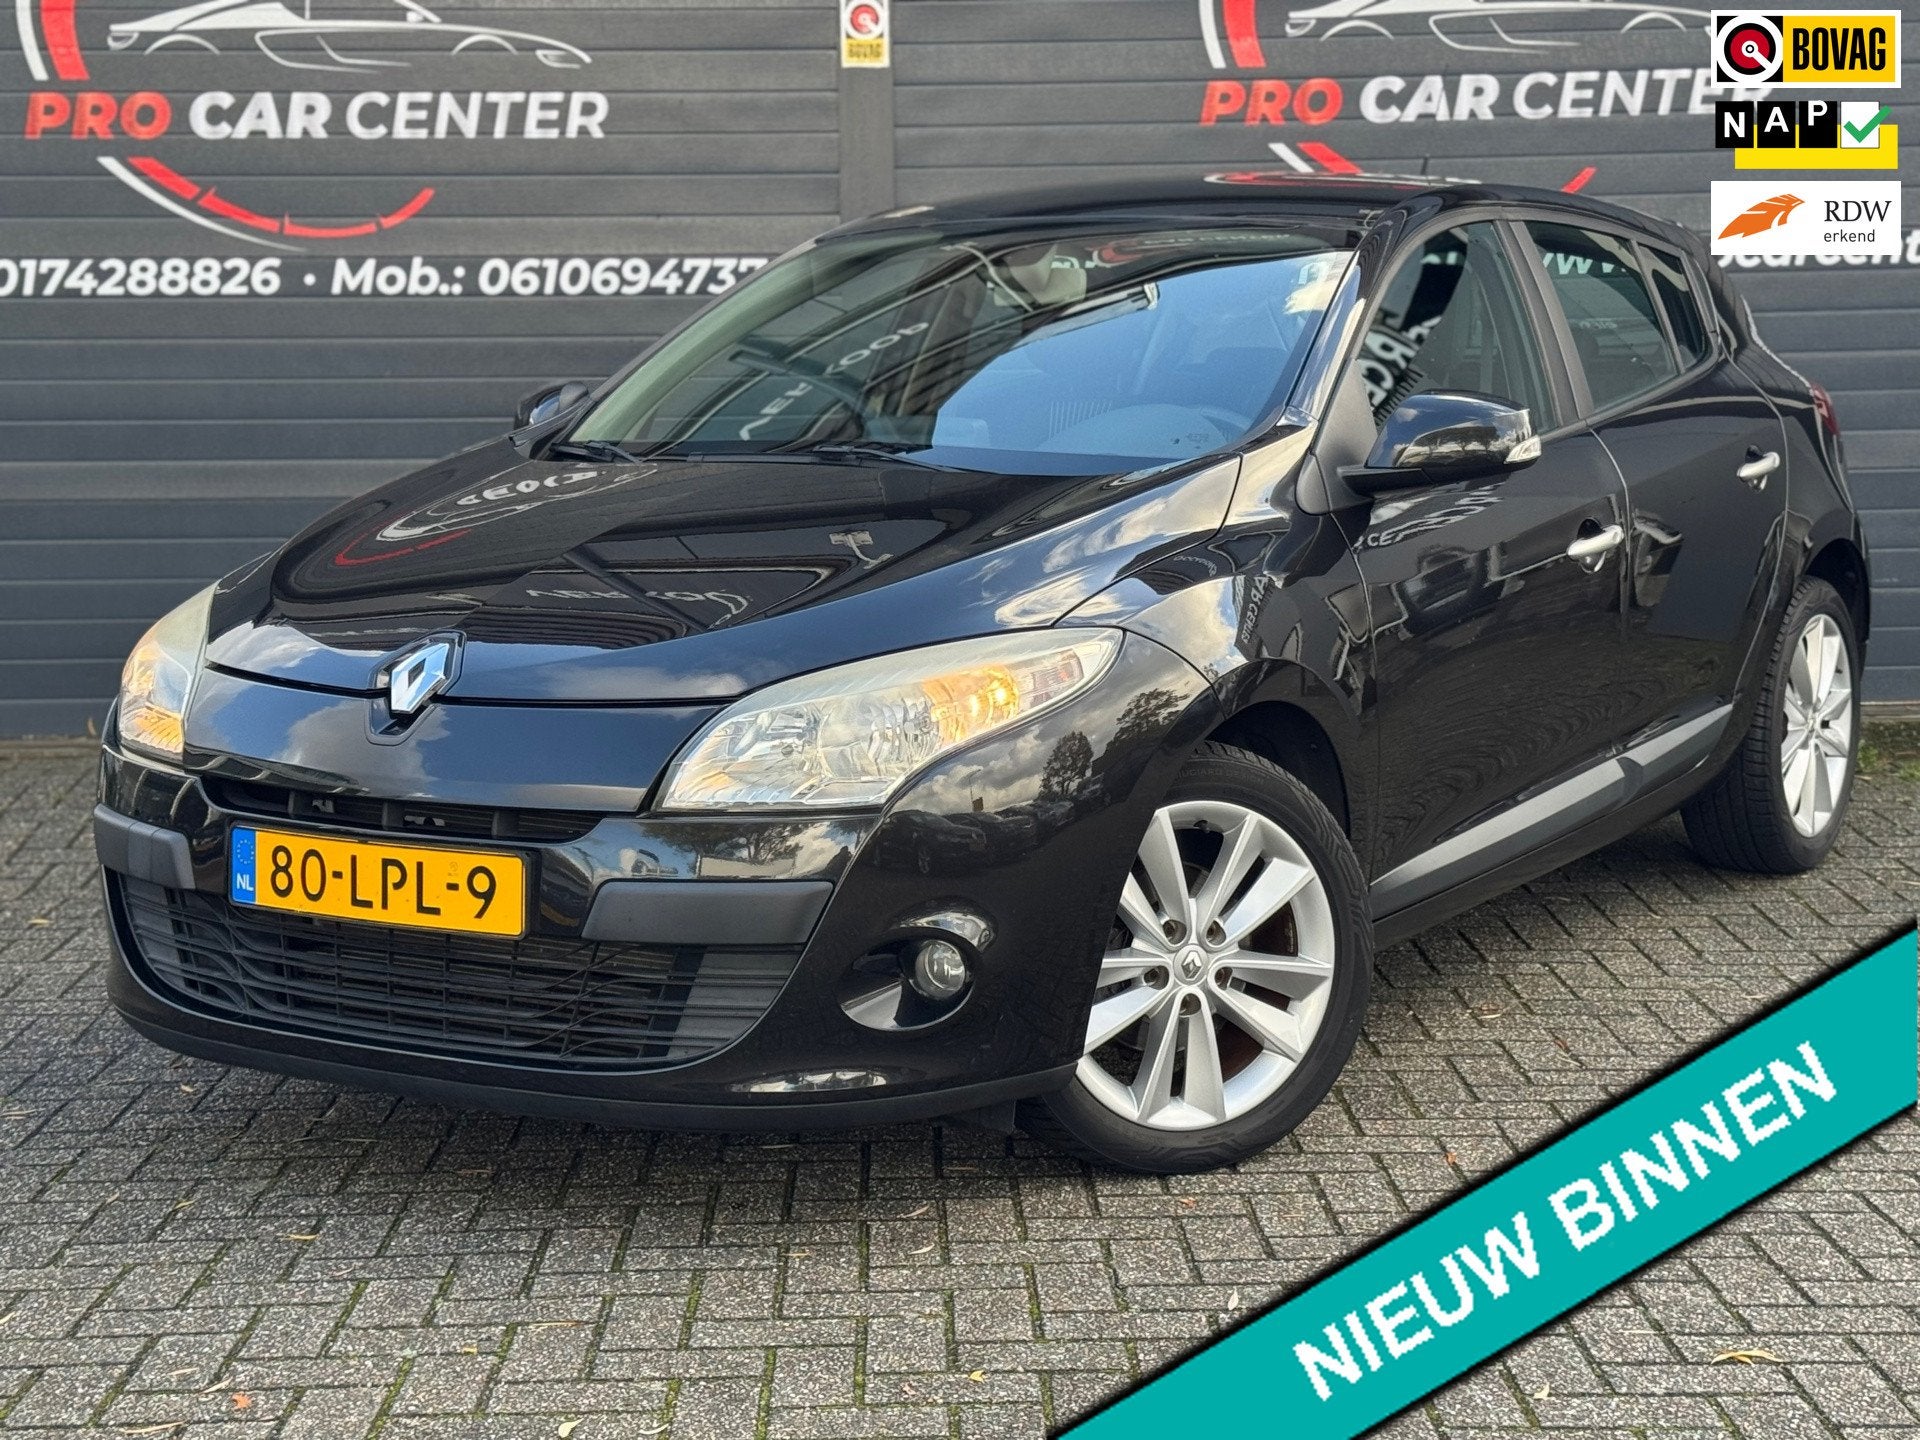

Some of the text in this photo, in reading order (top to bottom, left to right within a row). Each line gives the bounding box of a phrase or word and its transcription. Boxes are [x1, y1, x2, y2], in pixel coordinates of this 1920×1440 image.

[24, 92, 609, 140] PRO CAR CENTER
[1200, 68, 1773, 126] PRO CAR CENTE
[0, 257, 281, 297] 0174288826
[330, 256, 463, 296] Mob.:
[236, 872, 254, 891] NL
[270, 844, 497, 919] 80-LPL-9
